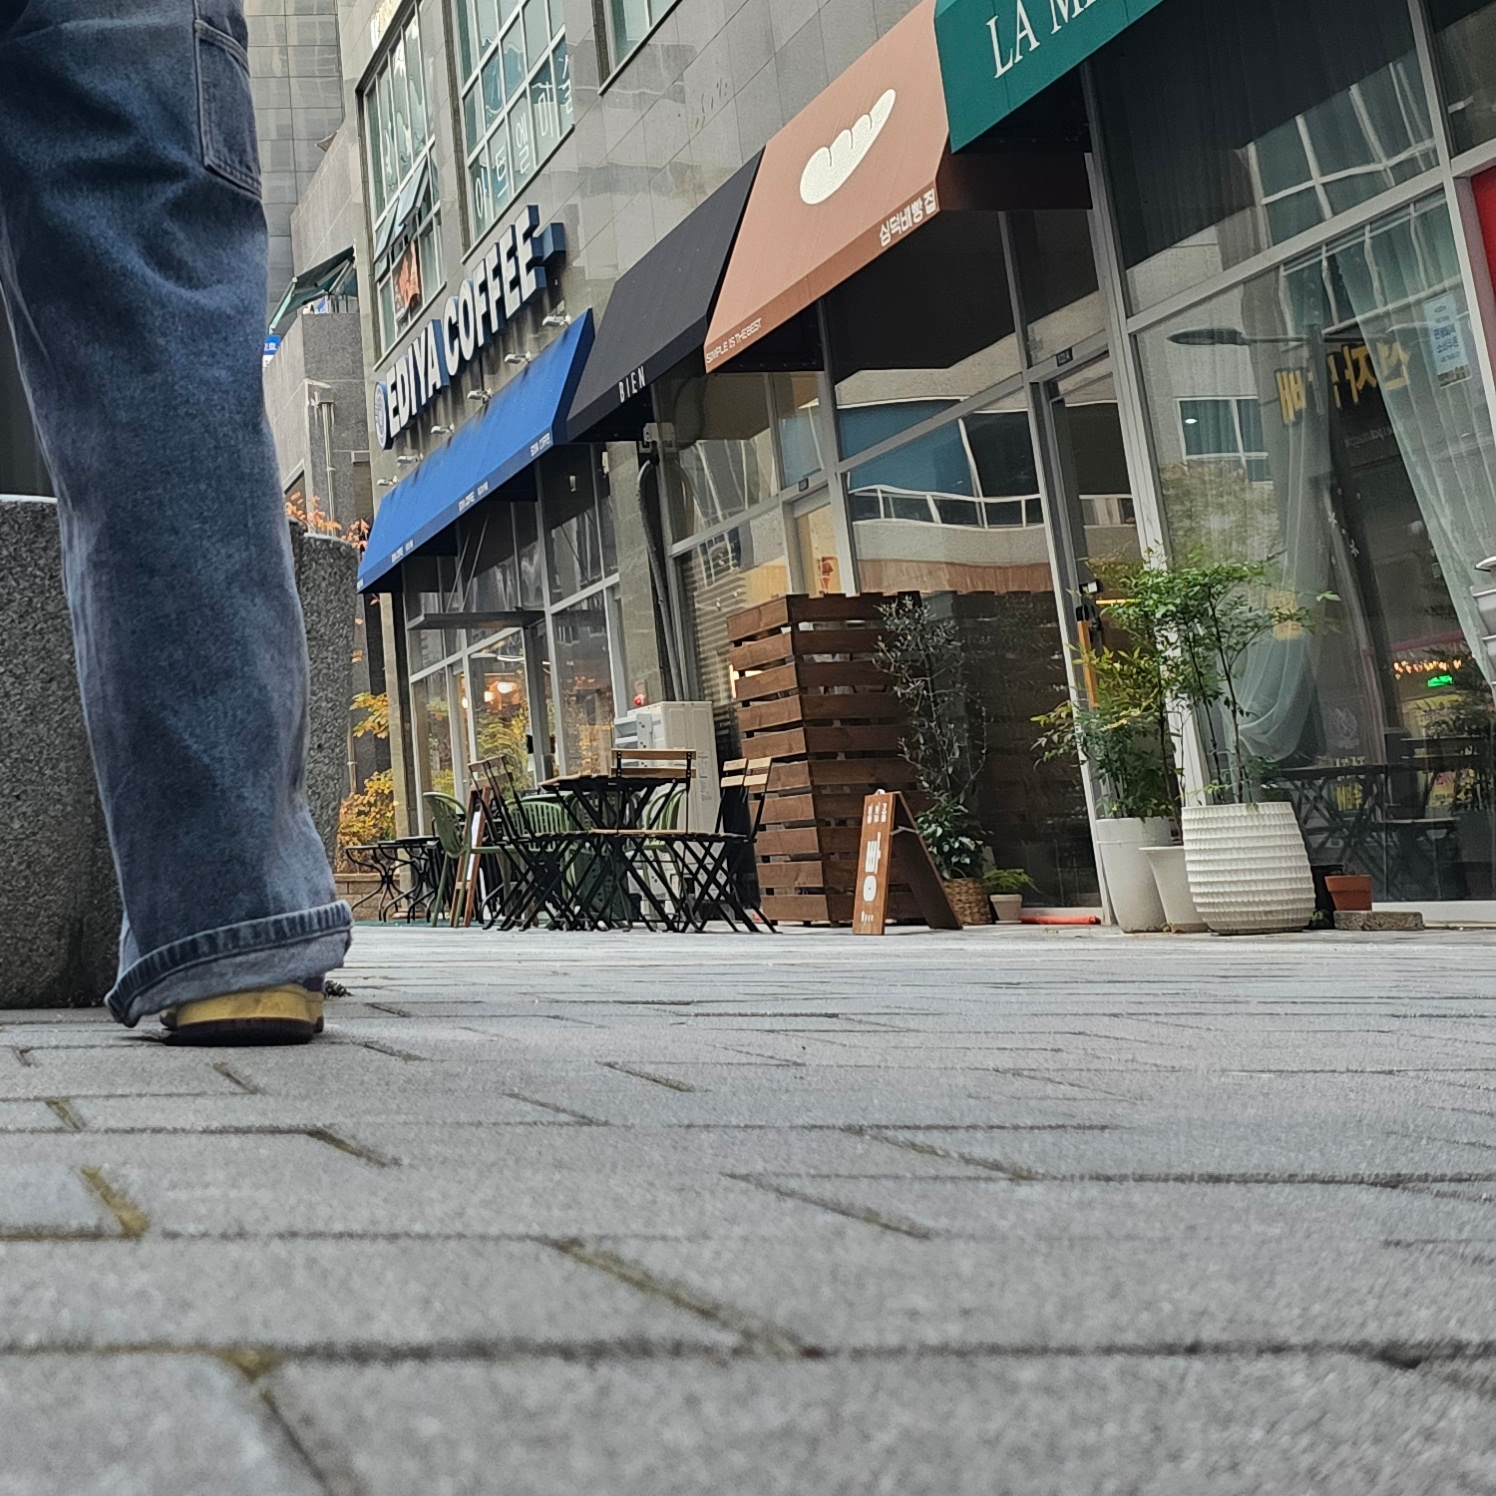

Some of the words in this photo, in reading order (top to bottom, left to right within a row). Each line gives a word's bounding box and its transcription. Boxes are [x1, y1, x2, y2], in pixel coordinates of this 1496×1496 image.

[386, 319, 447, 439] EDIYA
[444, 205, 544, 376] COFFEE
[618, 366, 646, 403] BIEN
